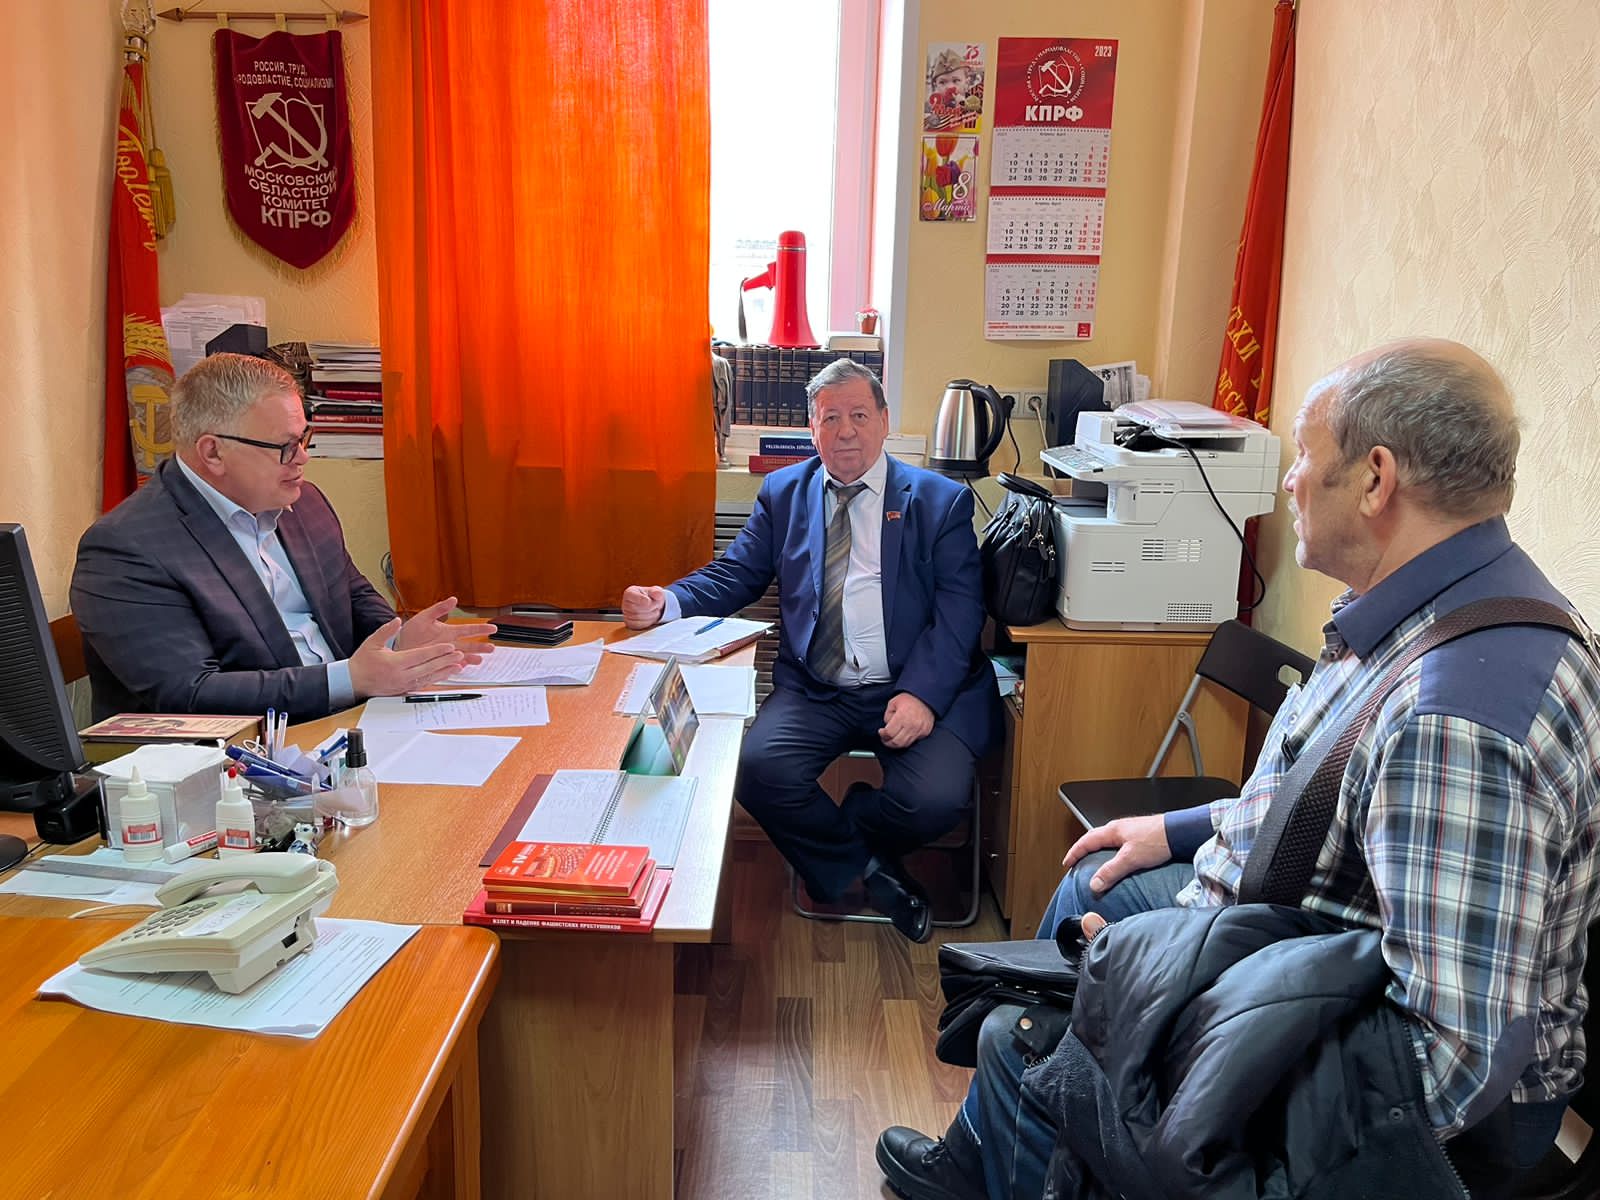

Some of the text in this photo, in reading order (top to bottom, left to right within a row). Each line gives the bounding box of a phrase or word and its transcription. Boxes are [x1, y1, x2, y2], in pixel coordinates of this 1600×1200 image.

[1094, 45, 1113, 57] 2023
[254, 61, 308, 76] РОССИЯ, ТРУД,
[1025, 105, 1084, 122] КПРФ
[953, 171, 971, 200] 8
[263, 194, 328, 210] КОМИТЕТ
[260, 205, 331, 228] КПРФ
